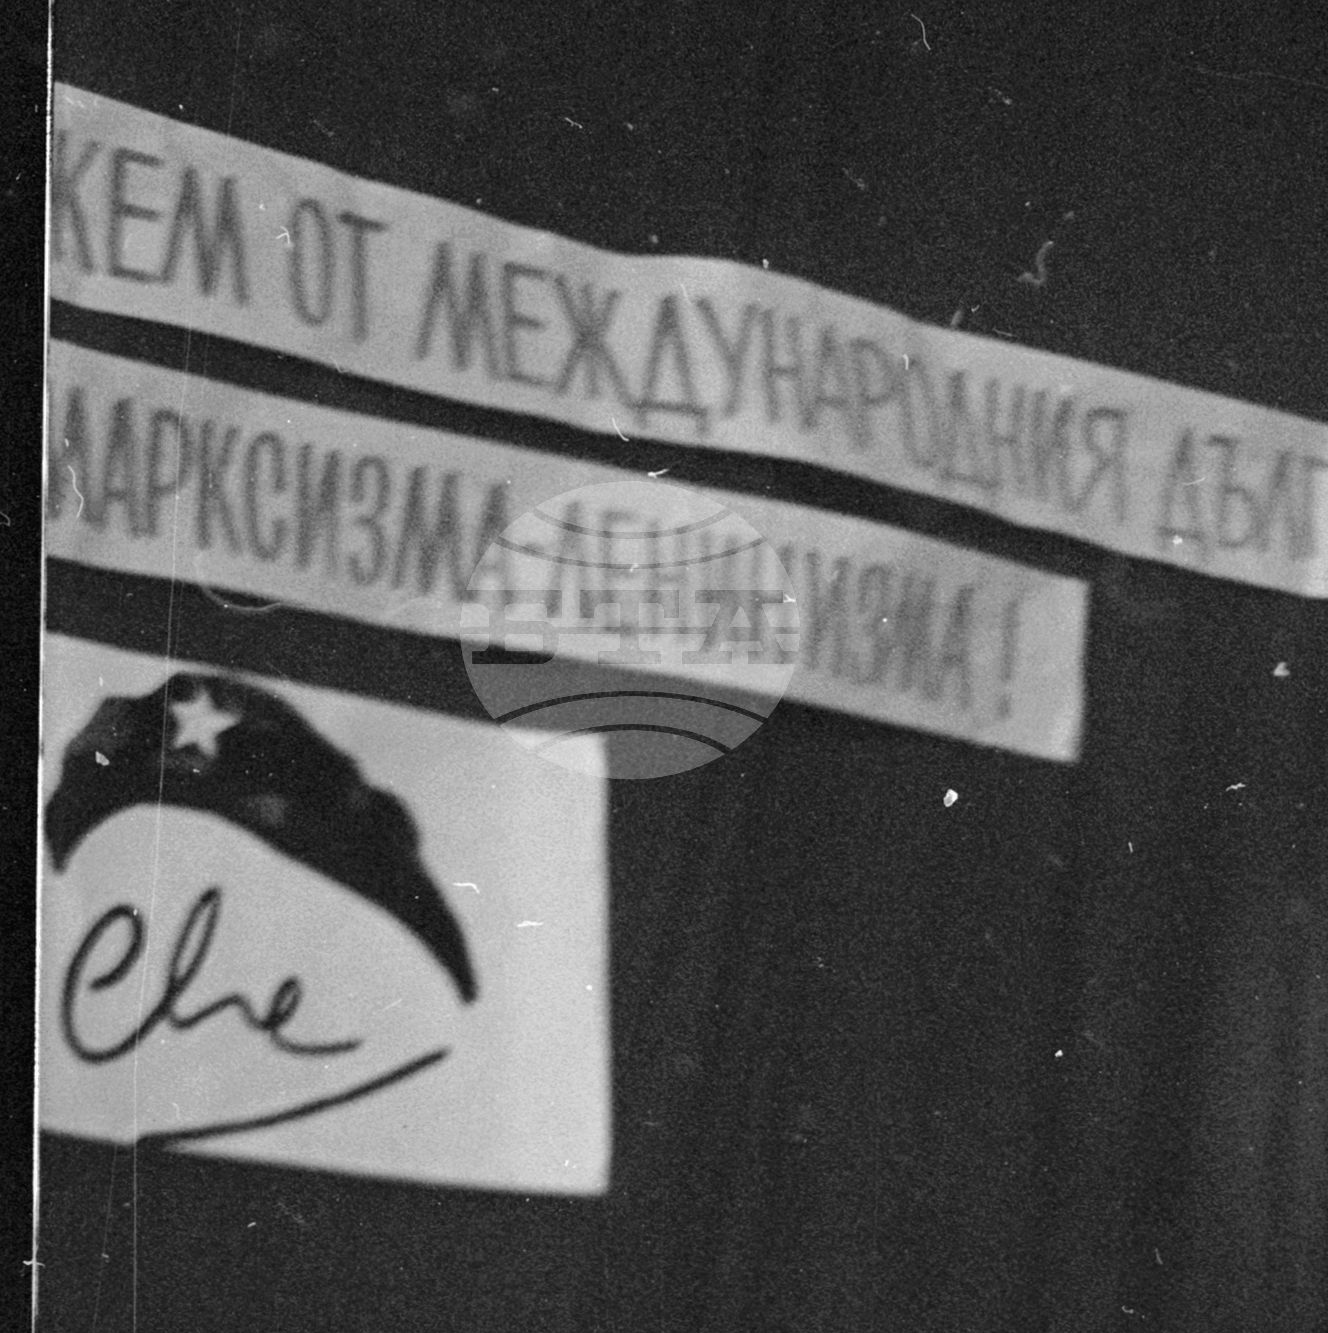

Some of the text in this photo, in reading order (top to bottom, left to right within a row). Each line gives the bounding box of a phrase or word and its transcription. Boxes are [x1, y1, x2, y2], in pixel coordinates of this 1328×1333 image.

[292, 198, 388, 344] ОТ
[416, 240, 1130, 524] МЕЖДУНАРОДНИЯ
[61, 885, 363, 1065] Che
